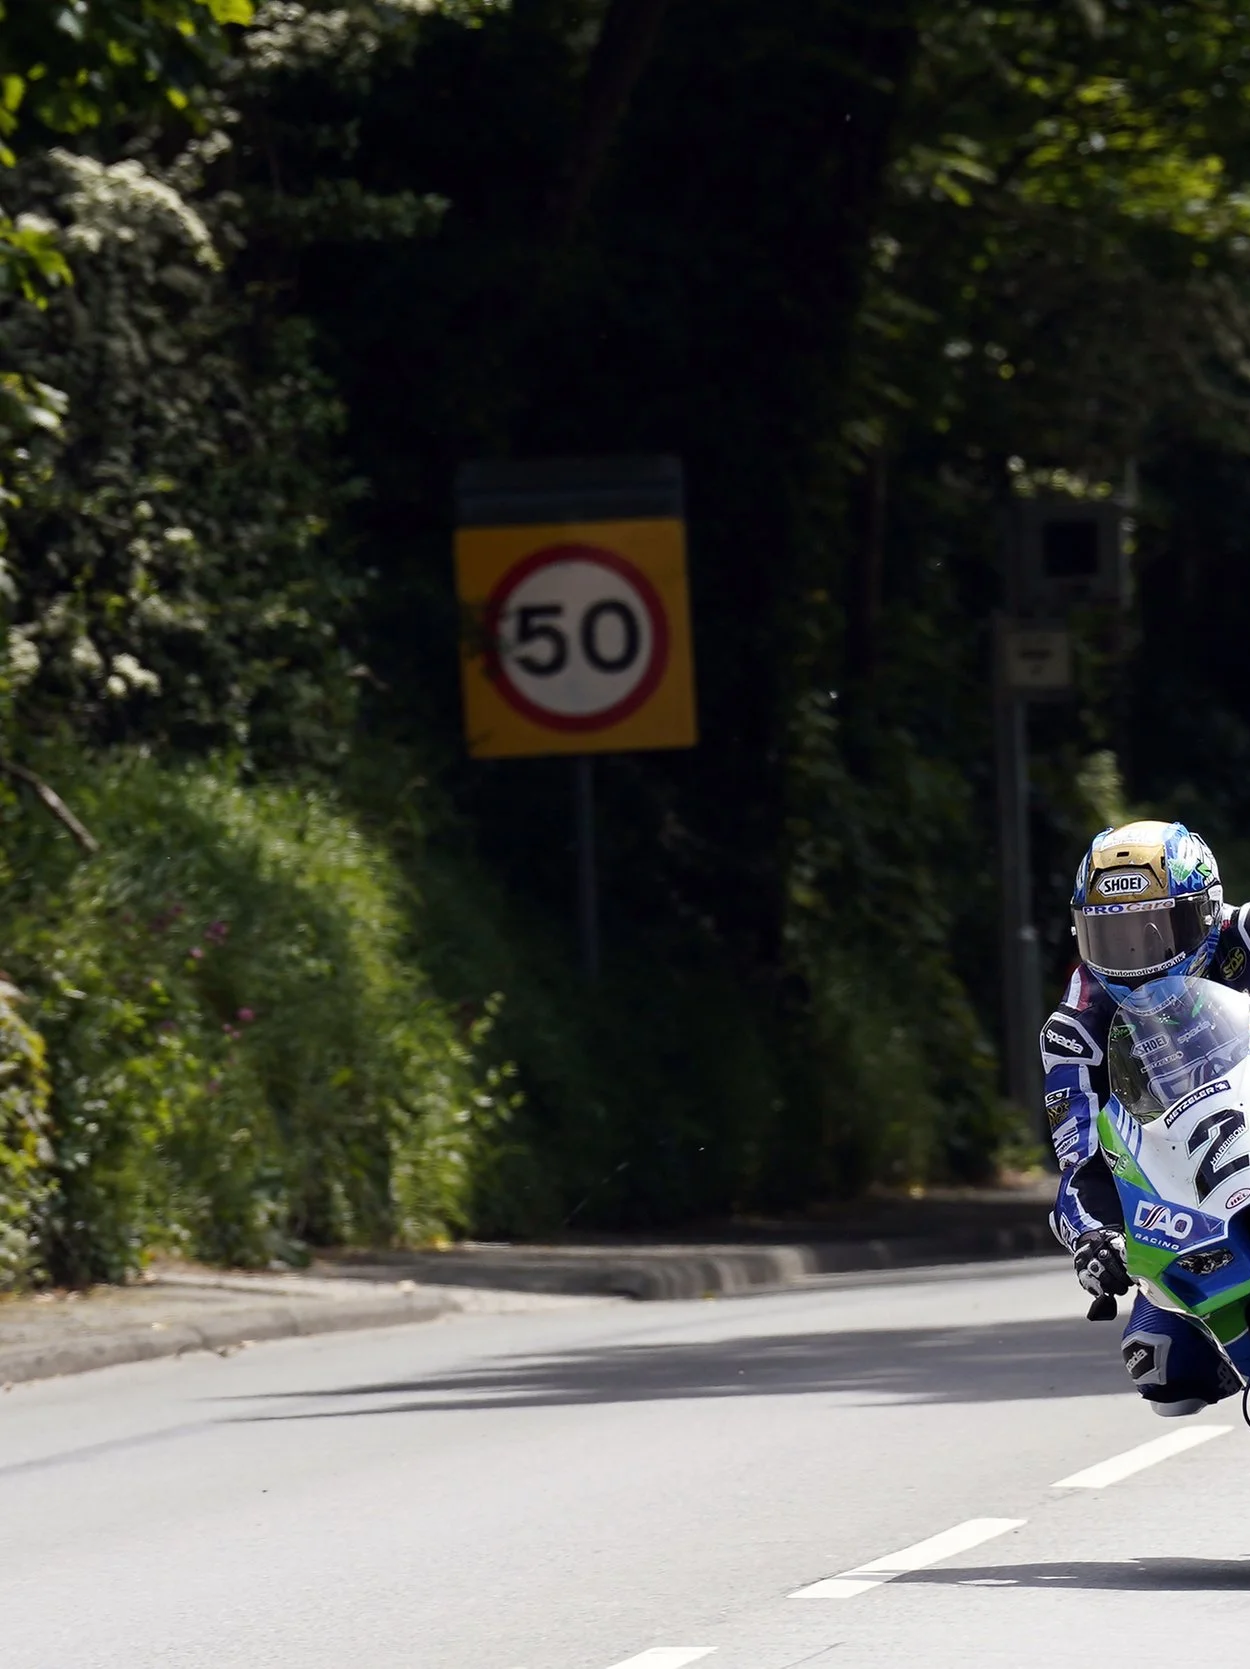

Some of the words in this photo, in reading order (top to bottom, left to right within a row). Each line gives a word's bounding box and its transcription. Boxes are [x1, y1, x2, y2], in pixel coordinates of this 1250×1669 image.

[514, 598, 642, 678] 50
[1103, 877, 1142, 893] SHOEI
[1046, 1029, 1084, 1054] spada
[1177, 1020, 1211, 1045] spada
[1166, 1087, 1214, 1126] METZELER
[1187, 1108, 1250, 1207] 2
[1210, 1124, 1247, 1167] HARRISON
[1134, 1200, 1193, 1239] DAO
[1135, 1233, 1180, 1250] RACING
